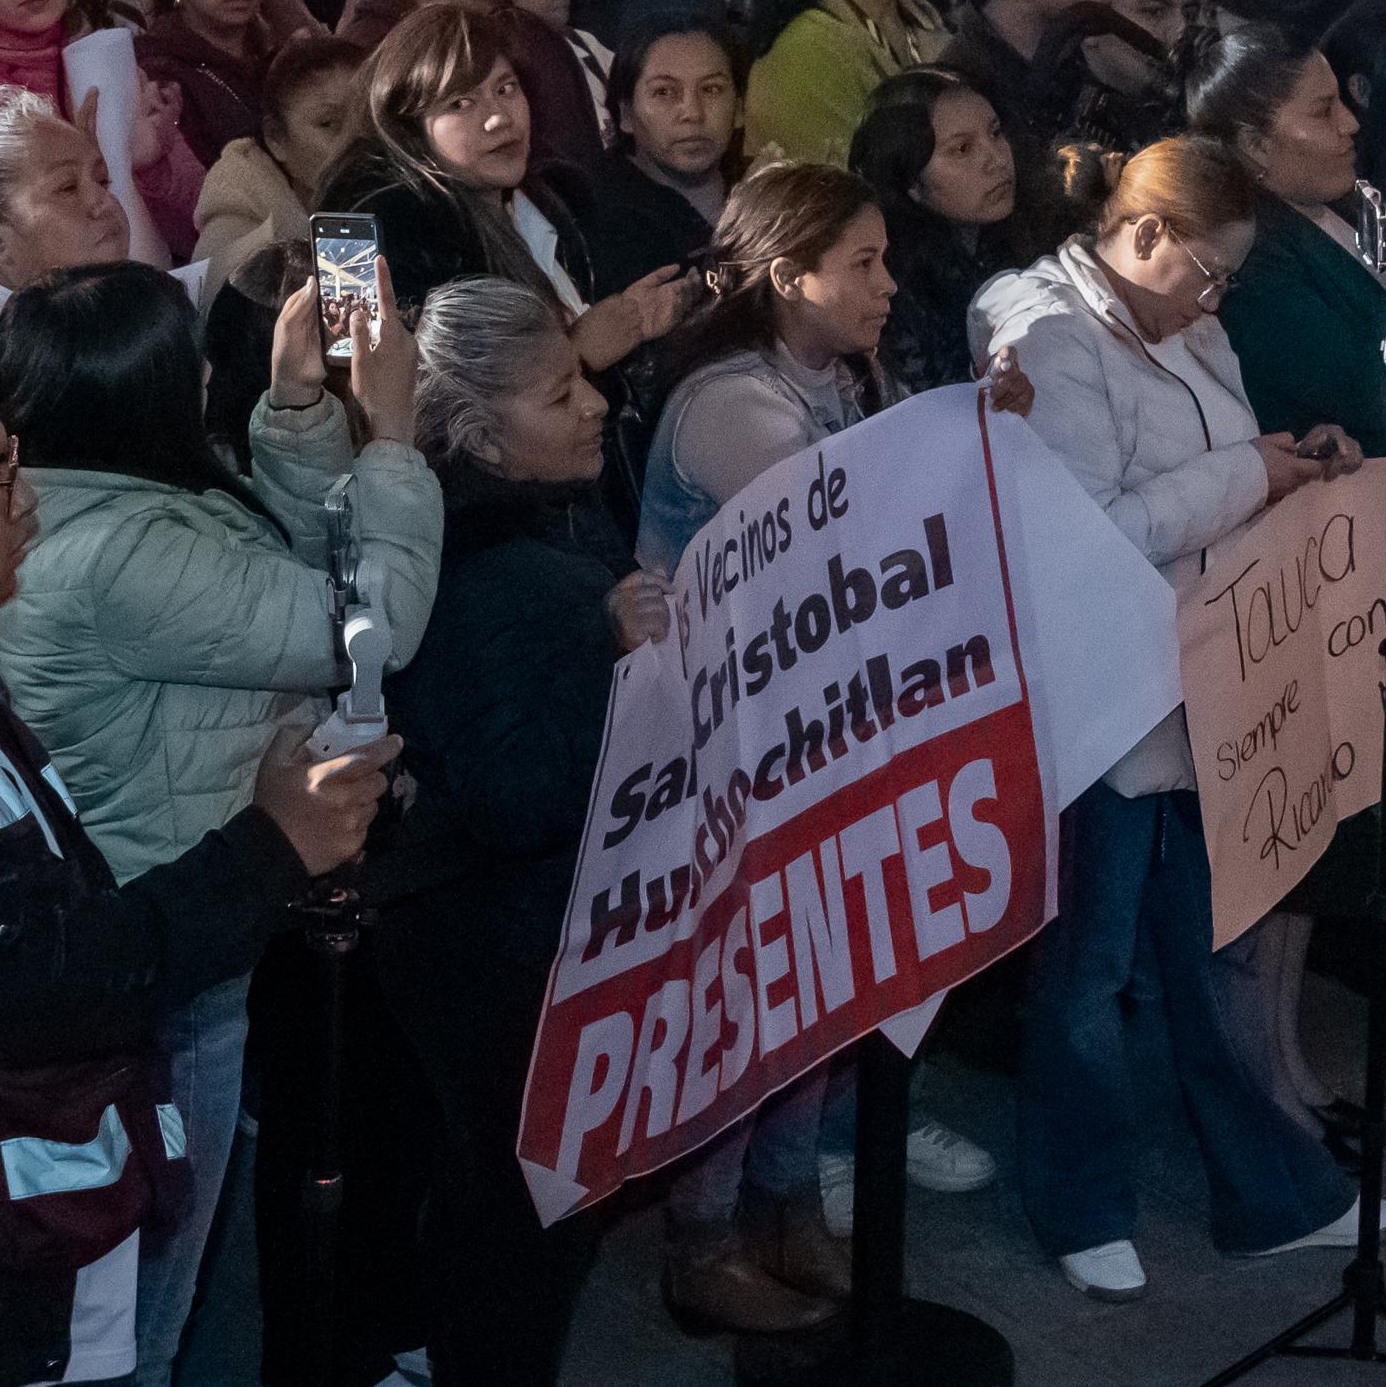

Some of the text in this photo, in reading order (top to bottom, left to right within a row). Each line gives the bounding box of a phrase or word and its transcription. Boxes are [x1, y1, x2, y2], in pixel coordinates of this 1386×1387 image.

[689, 512, 954, 751] Cristobal
[695, 450, 850, 623] Vecinos de
[554, 757, 1013, 1182] PRESENTES
